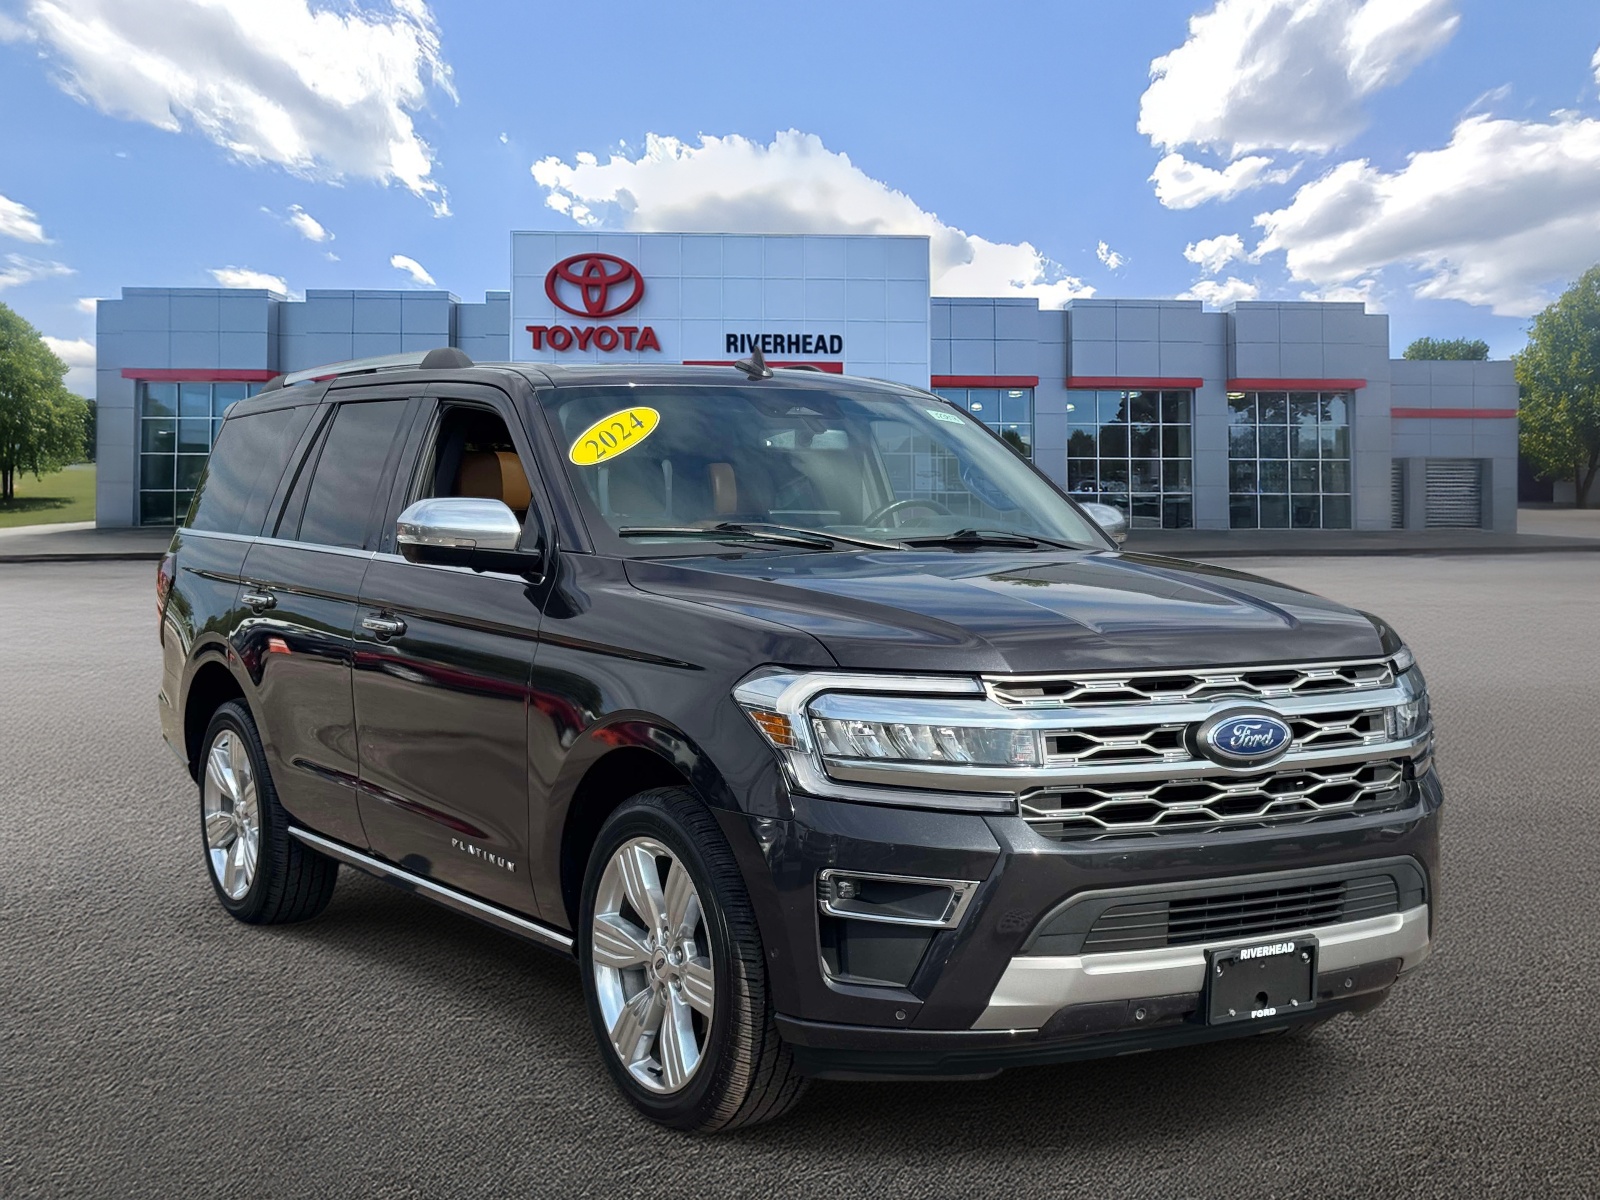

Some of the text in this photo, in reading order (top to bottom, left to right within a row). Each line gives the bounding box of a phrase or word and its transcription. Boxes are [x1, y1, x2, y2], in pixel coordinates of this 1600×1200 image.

[525, 325, 661, 352] TOYOTA
[726, 333, 843, 354] RIVERHEAD
[585, 412, 644, 459] 2024
[1230, 724, 1274, 748] Ford
[451, 837, 515, 873] PLATINUM
[1240, 942, 1295, 960] RIVERHEAD
[1251, 1008, 1276, 1019] FORD
